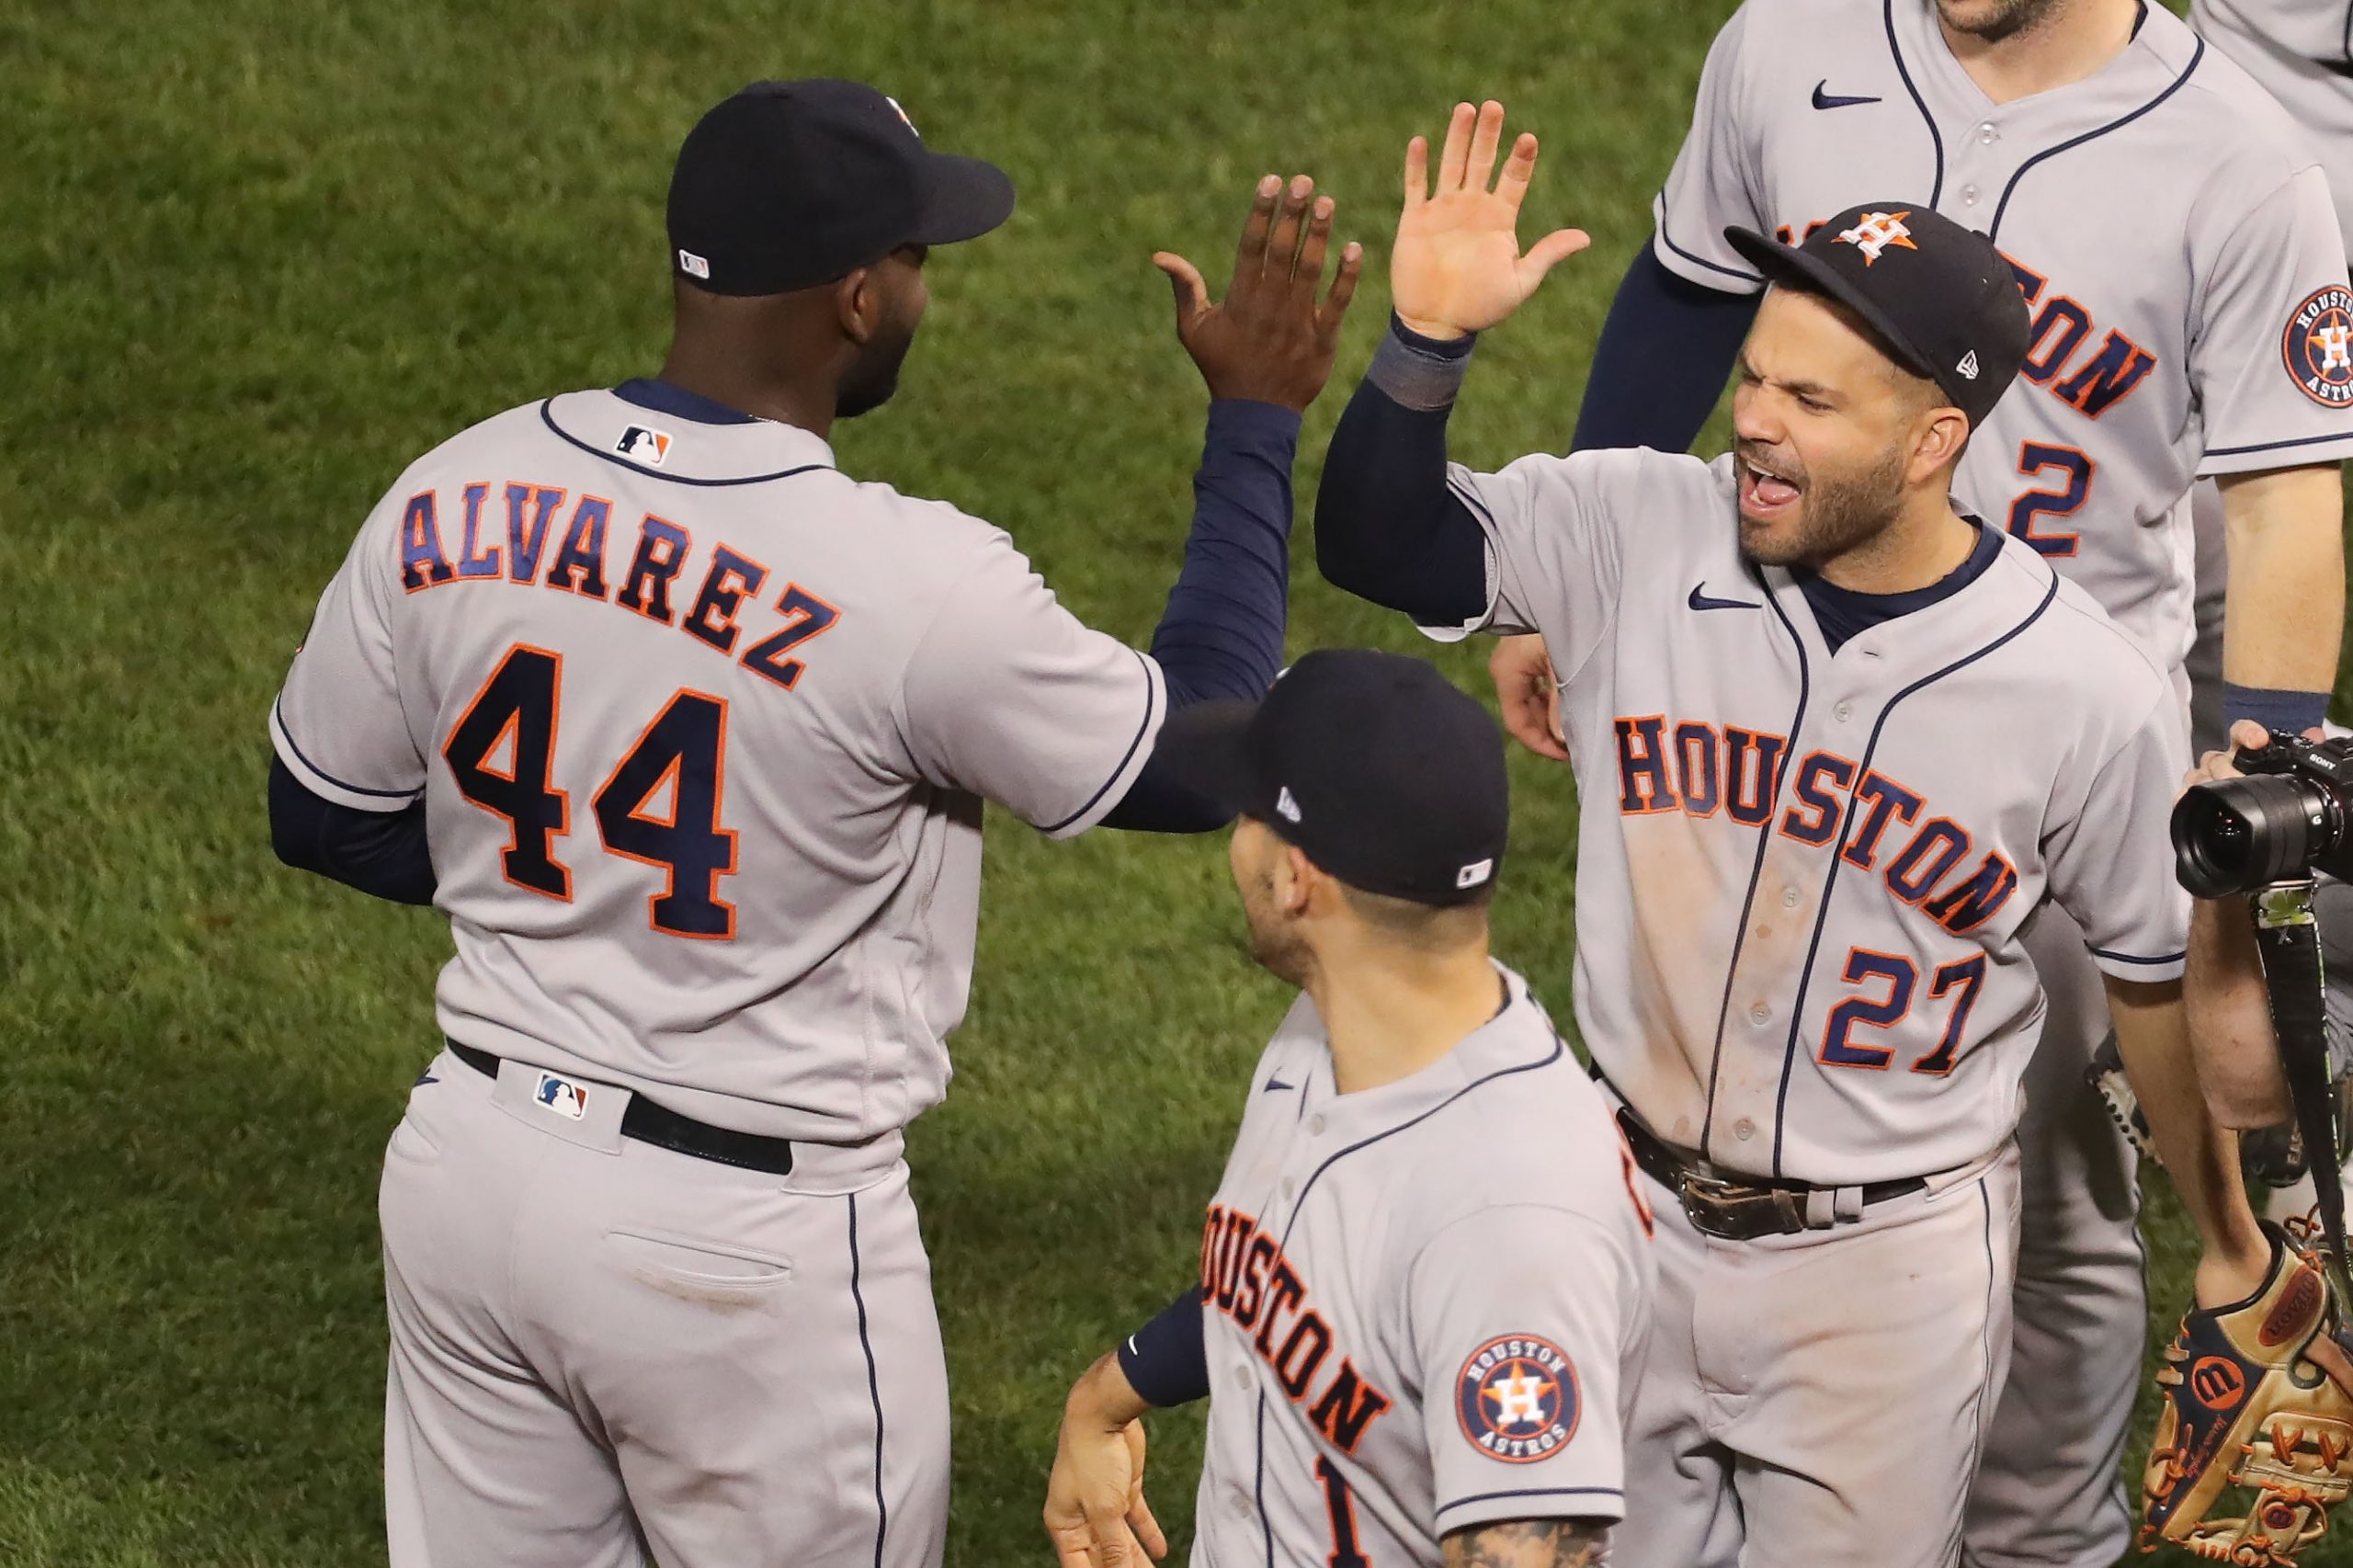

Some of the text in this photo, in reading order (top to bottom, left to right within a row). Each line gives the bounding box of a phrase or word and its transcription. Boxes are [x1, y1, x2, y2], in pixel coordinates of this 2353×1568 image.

[2297, 291, 2353, 329] HOUSTO
[2006, 439, 2097, 557] 2
[398, 481, 842, 691] ALVAREZ
[441, 642, 738, 940] 44
[2309, 754, 2336, 770] SONY
[1614, 713, 2018, 936] HOUSTON
[1815, 946, 1987, 1076] 27
[1467, 1340, 1566, 1381] HOUSTON
[1494, 1376, 1545, 1423] H
[1479, 1424, 1566, 1456] ASTROS
